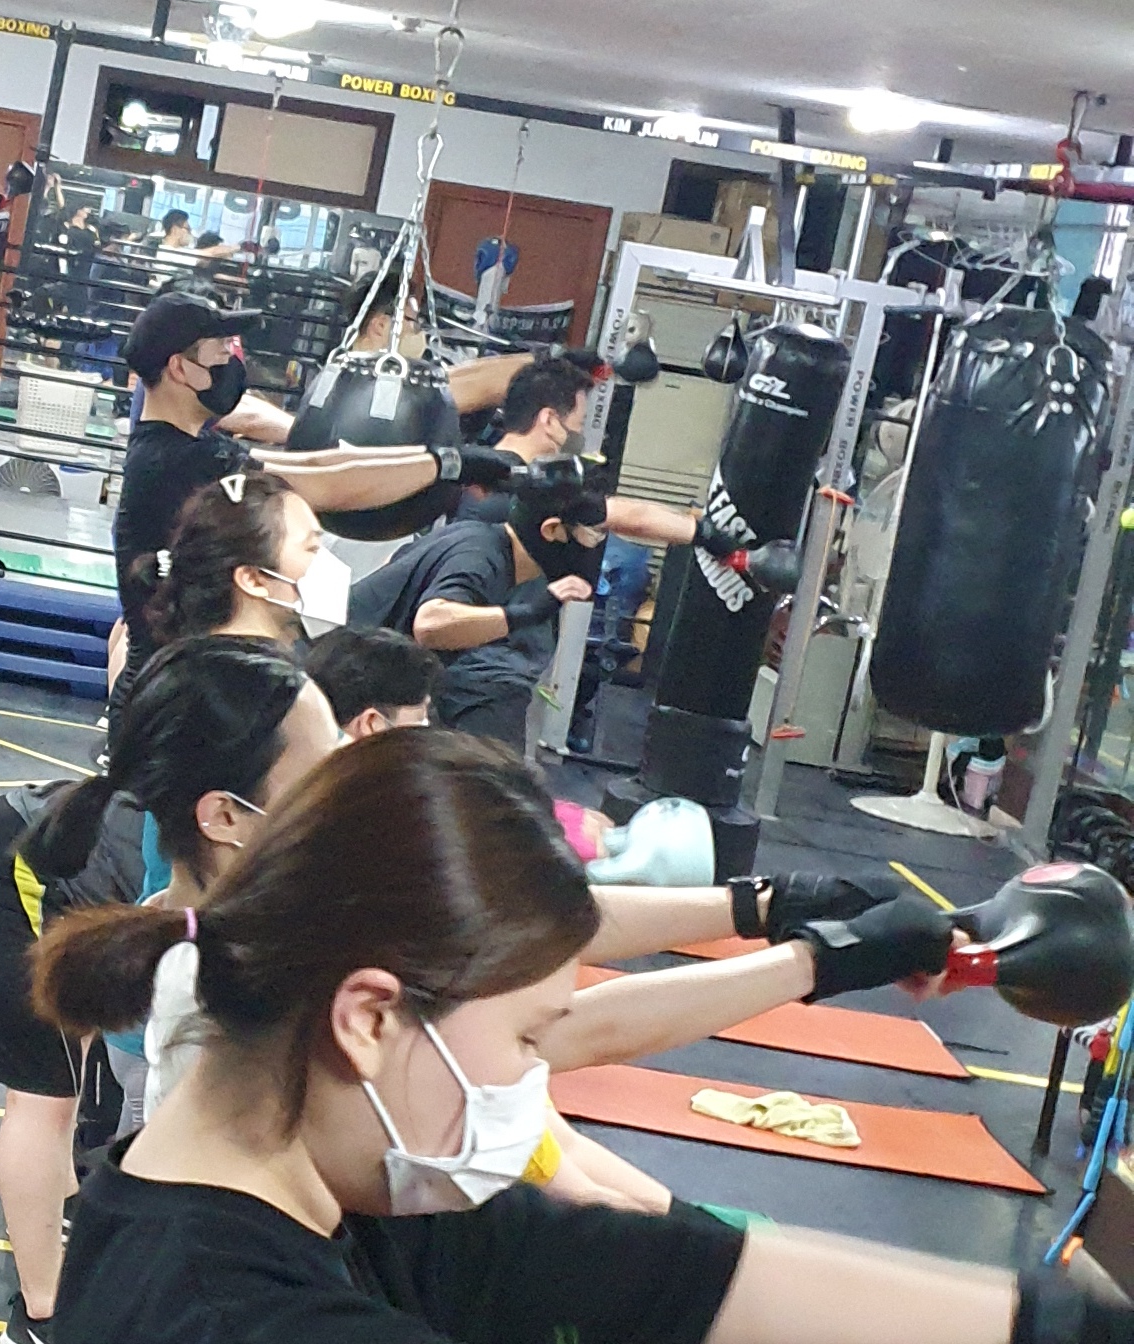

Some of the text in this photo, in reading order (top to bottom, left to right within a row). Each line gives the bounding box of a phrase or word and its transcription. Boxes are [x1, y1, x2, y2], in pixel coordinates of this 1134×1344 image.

[341, 73, 456, 105] POWER BOXIG
[603, 116, 631, 133] KIM
[708, 490, 758, 544] FAST
